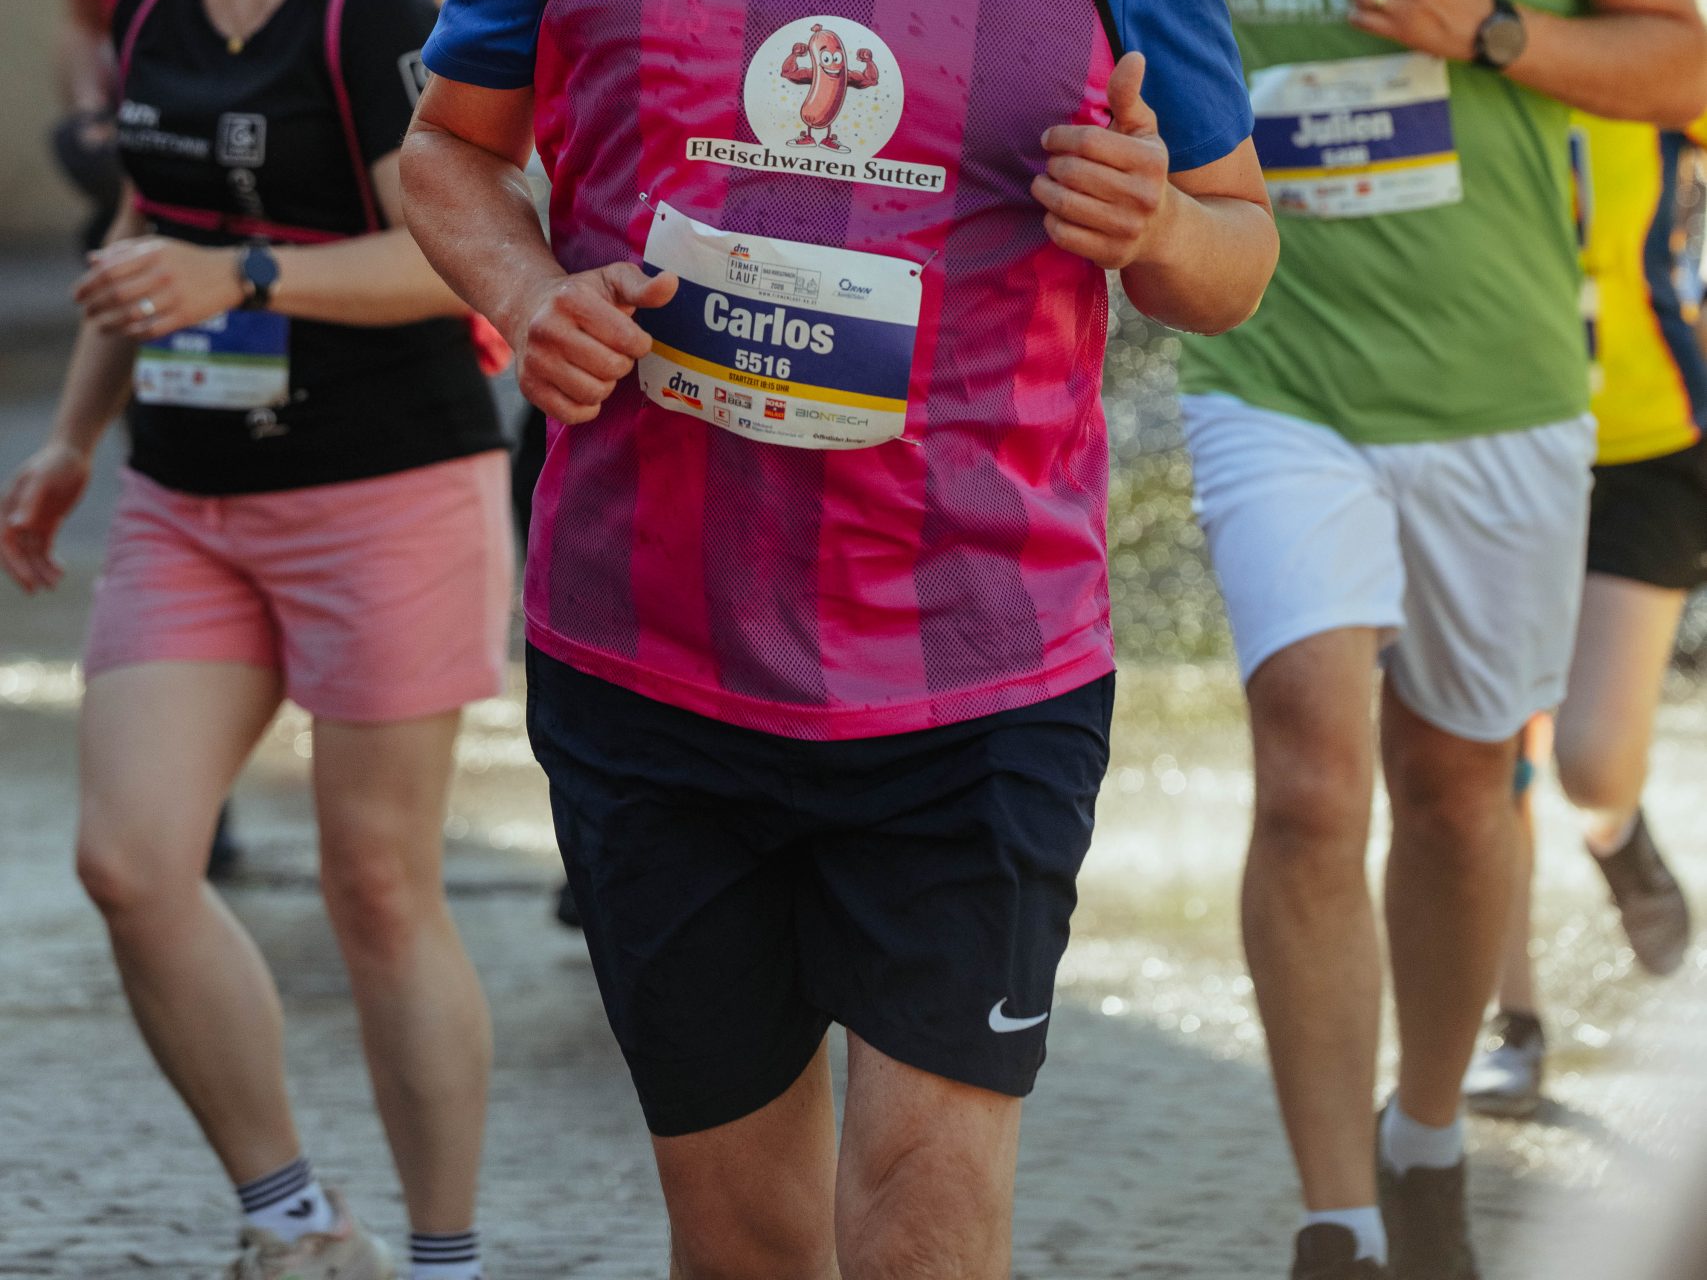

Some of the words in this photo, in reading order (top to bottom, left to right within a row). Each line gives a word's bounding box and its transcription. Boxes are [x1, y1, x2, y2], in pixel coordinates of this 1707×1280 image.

[690, 140, 856, 178] Fleischwaren
[863, 161, 942, 188] Sutter
[733, 243, 749, 253] dm
[731, 260, 759, 272] FIRMEN
[729, 269, 757, 285] LAUF
[703, 292, 836, 355] Carlos
[734, 348, 791, 380] 5516
[668, 371, 700, 399] dm
[728, 372, 759, 387] STARTZEIT
[776, 383, 790, 392] UHR
[795, 407, 869, 427] BIONTECH
